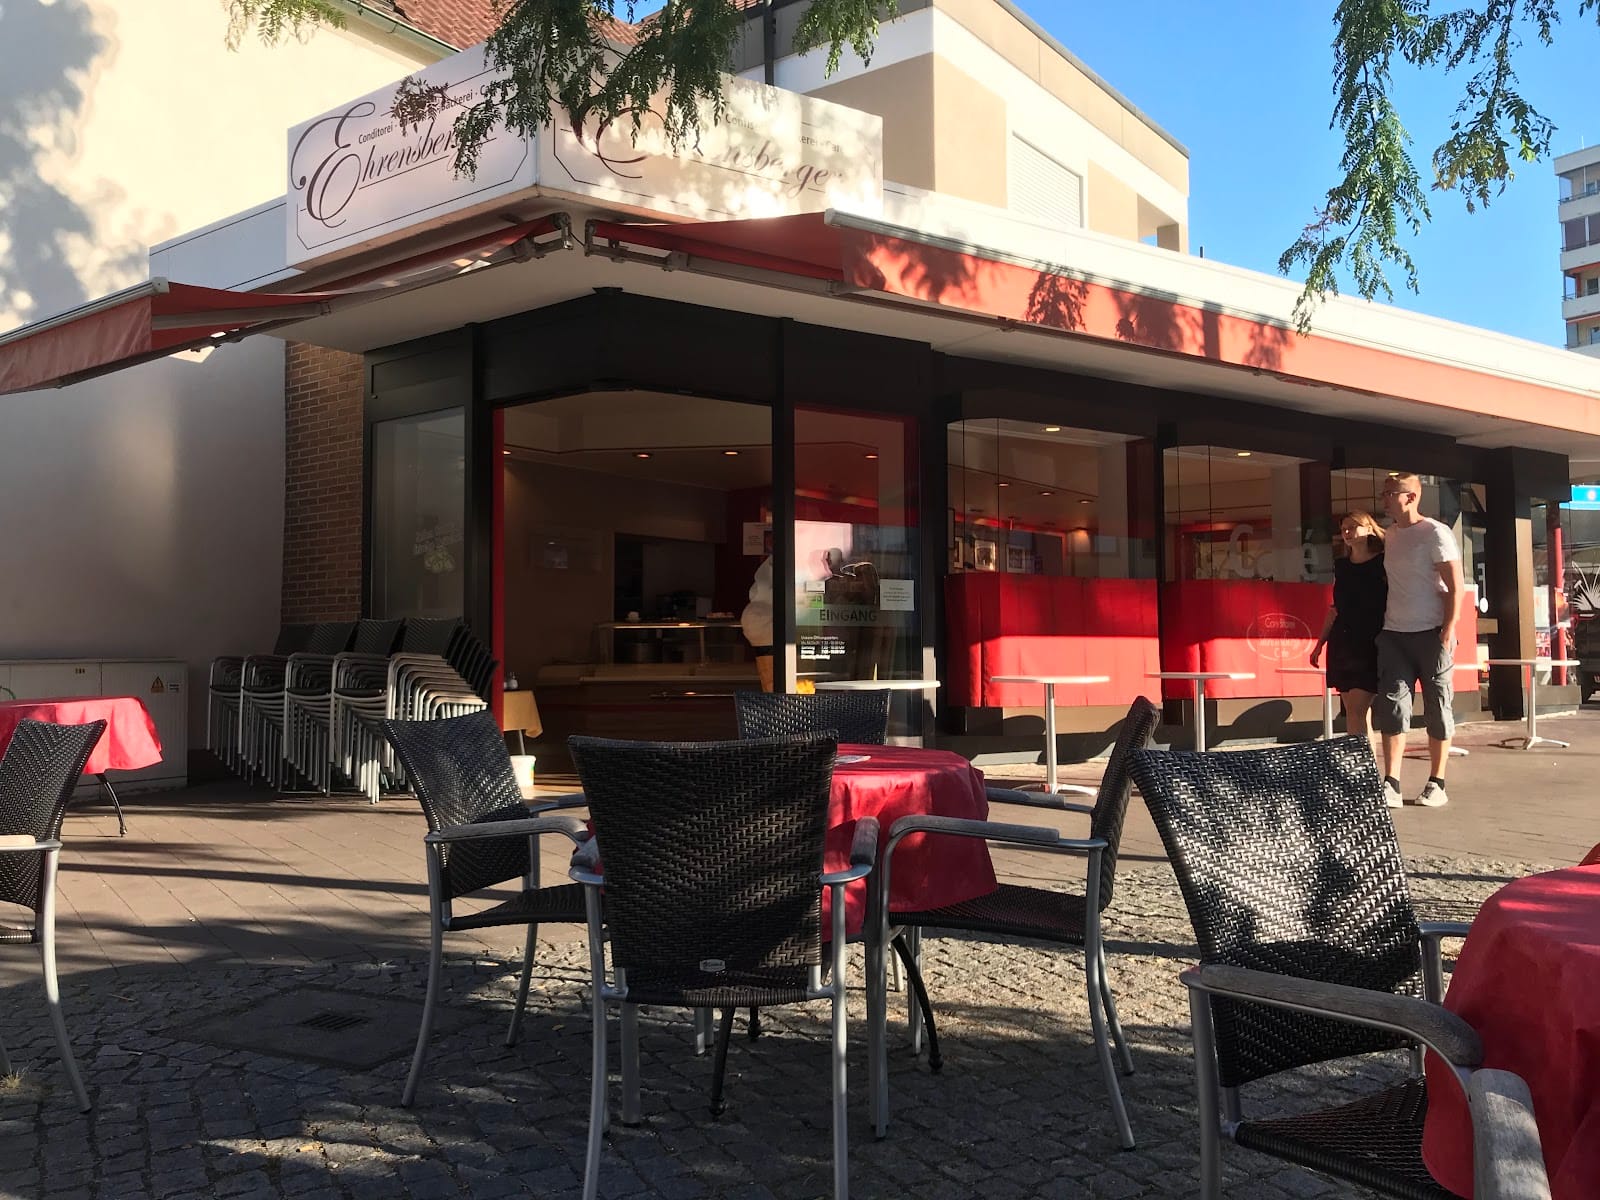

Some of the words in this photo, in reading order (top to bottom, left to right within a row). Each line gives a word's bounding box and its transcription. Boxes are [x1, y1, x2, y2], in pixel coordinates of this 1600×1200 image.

[358, 121, 394, 145] Conditorei
[291, 101, 484, 229] Ehrensber
[820, 609, 877, 622] EINGANG
